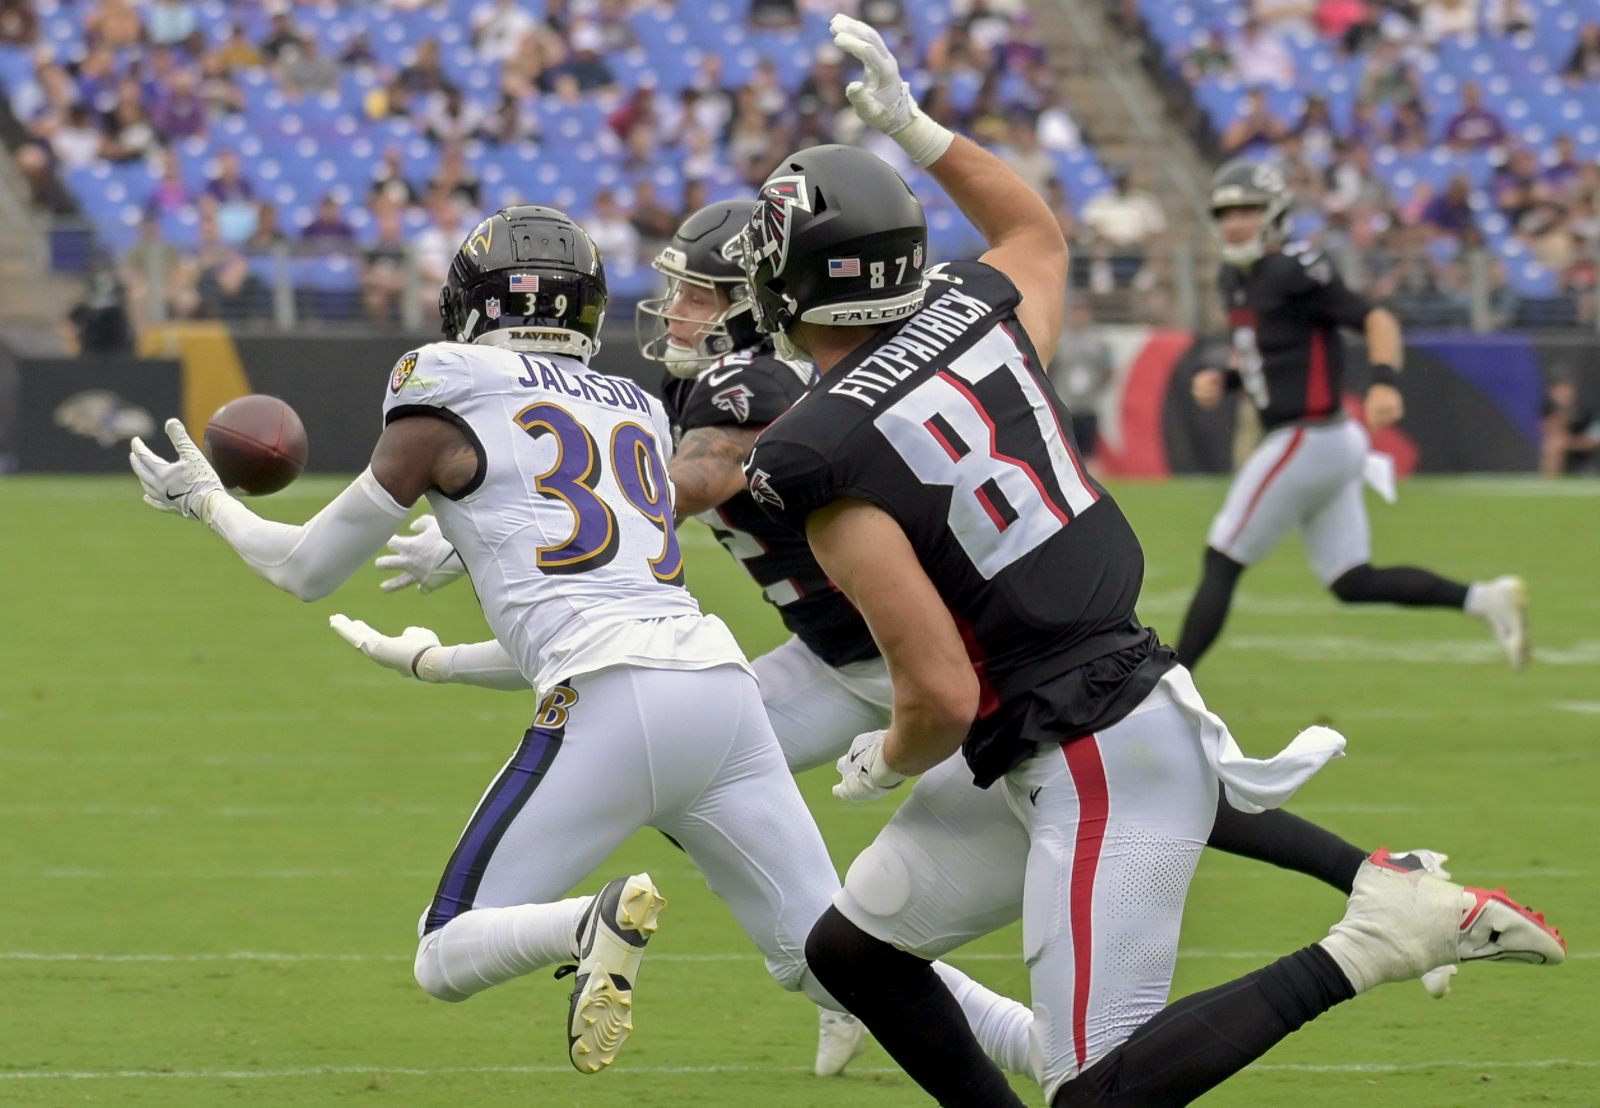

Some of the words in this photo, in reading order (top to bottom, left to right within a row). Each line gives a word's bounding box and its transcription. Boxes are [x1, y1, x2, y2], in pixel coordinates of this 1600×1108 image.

[508, 330, 571, 342] RAVENS
[831, 298, 924, 322] FALCONS
[828, 287, 992, 407] FITZPATRICK
[518, 354, 652, 417] JACKSON
[873, 321, 1100, 580] 87
[512, 401, 685, 587] 39
[533, 685, 579, 729] B
